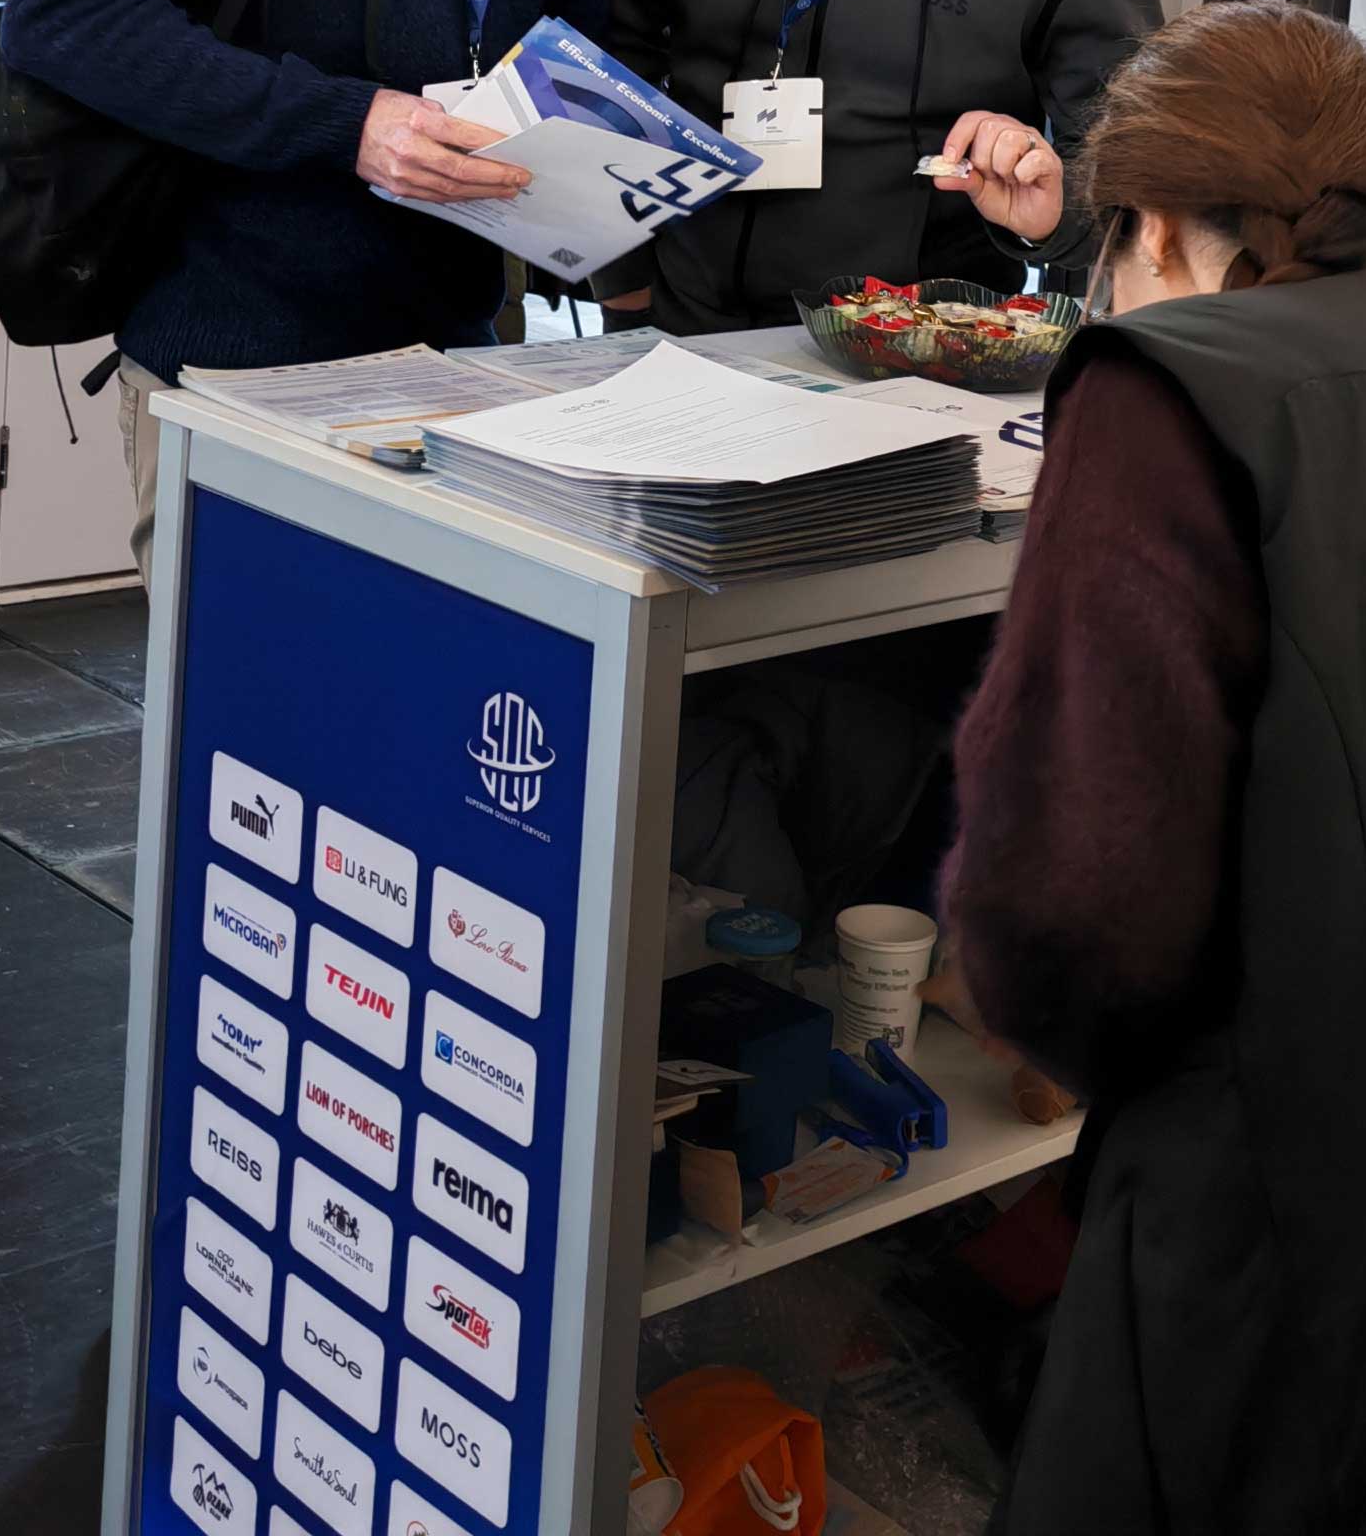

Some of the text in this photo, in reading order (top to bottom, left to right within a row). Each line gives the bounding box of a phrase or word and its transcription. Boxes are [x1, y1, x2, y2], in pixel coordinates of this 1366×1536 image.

[557, 38, 609, 81] Efficient
[615, 81, 674, 128] Economic
[681, 127, 738, 167] Excellent
[231, 800, 270, 840] PUMA
[369, 870, 407, 908] FUNG
[324, 963, 395, 1020] TEIJIN
[454, 1045, 525, 1097] CONCORDIA
[306, 1080, 395, 1153] LION OF PORCHES
[208, 1127, 263, 1183] REISS
[432, 1156, 514, 1235] reima
[307, 1217, 336, 1247] HAWES
[343, 1243, 374, 1273] CURTIS
[303, 1320, 363, 1380] bebe
[420, 1406, 481, 1468] MOSS
